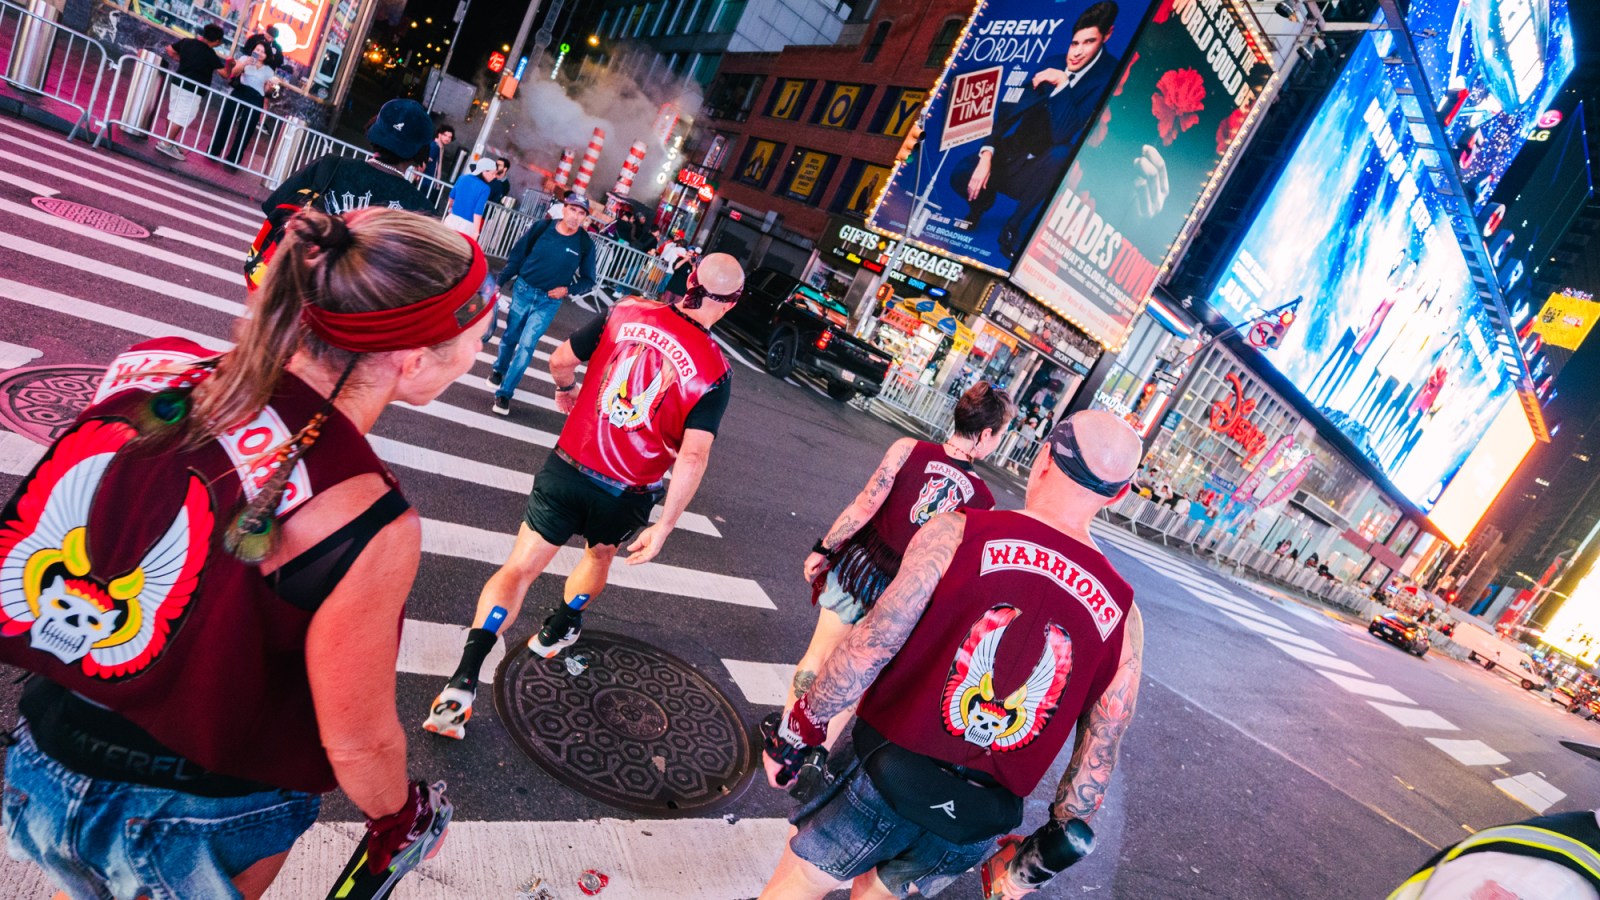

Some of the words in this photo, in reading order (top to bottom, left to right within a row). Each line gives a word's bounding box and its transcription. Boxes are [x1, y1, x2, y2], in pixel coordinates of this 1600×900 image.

[979, 18, 1064, 36] JEREMY
[1215, 8, 1234, 39] SEE
[1226, 26, 1247, 58] HOW
[1240, 46, 1258, 76] THE
[964, 36, 1052, 63] JORDAN
[1206, 38, 1243, 95] COULD
[956, 77, 986, 104] JUST
[955, 100, 993, 122] TIME
[1528, 130, 1549, 141] LG
[657, 136, 682, 185] 1540
[838, 224, 880, 251] GIFTS
[886, 240, 964, 282] LUGGAGE
[935, 225, 973, 245] BROADWAY
[1053, 188, 1158, 300] HADESTOWN
[890, 269, 906, 283] ONY
[1038, 229, 1087, 269] BROADWAY'S
[1080, 264, 1109, 288] GLOBAL
[622, 323, 695, 379] WARRIORS
[1052, 349, 1074, 366] SONY
[929, 461, 973, 498] WARRIORS
[987, 543, 1116, 630] WARRIORS
